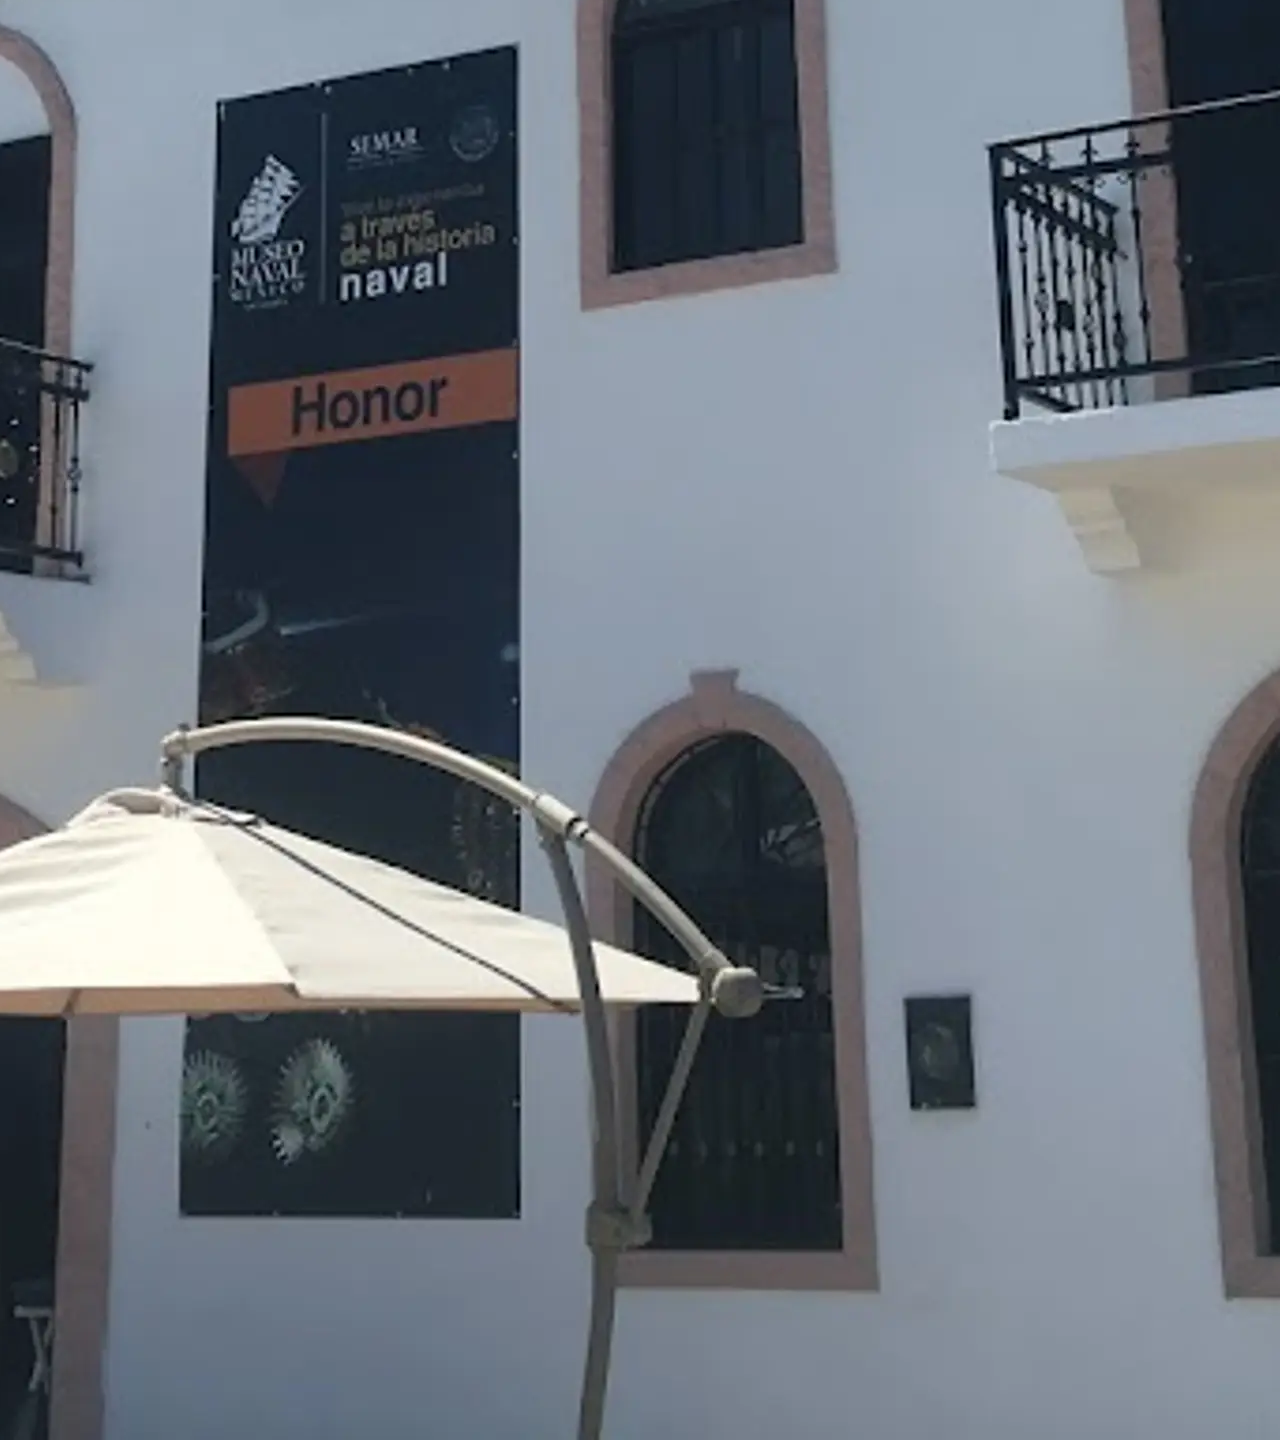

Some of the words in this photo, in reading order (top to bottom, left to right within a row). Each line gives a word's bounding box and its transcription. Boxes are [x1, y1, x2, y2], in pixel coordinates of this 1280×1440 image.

[350, 126, 418, 156] SEMAR
[340, 244, 371, 269] de
[376, 236, 400, 262] la
[403, 222, 497, 258] historia
[341, 220, 356, 244] a
[231, 239, 305, 265] MUSEO
[231, 258, 308, 290] NAVAL
[339, 252, 449, 302] naval
[291, 375, 449, 436] Honor
